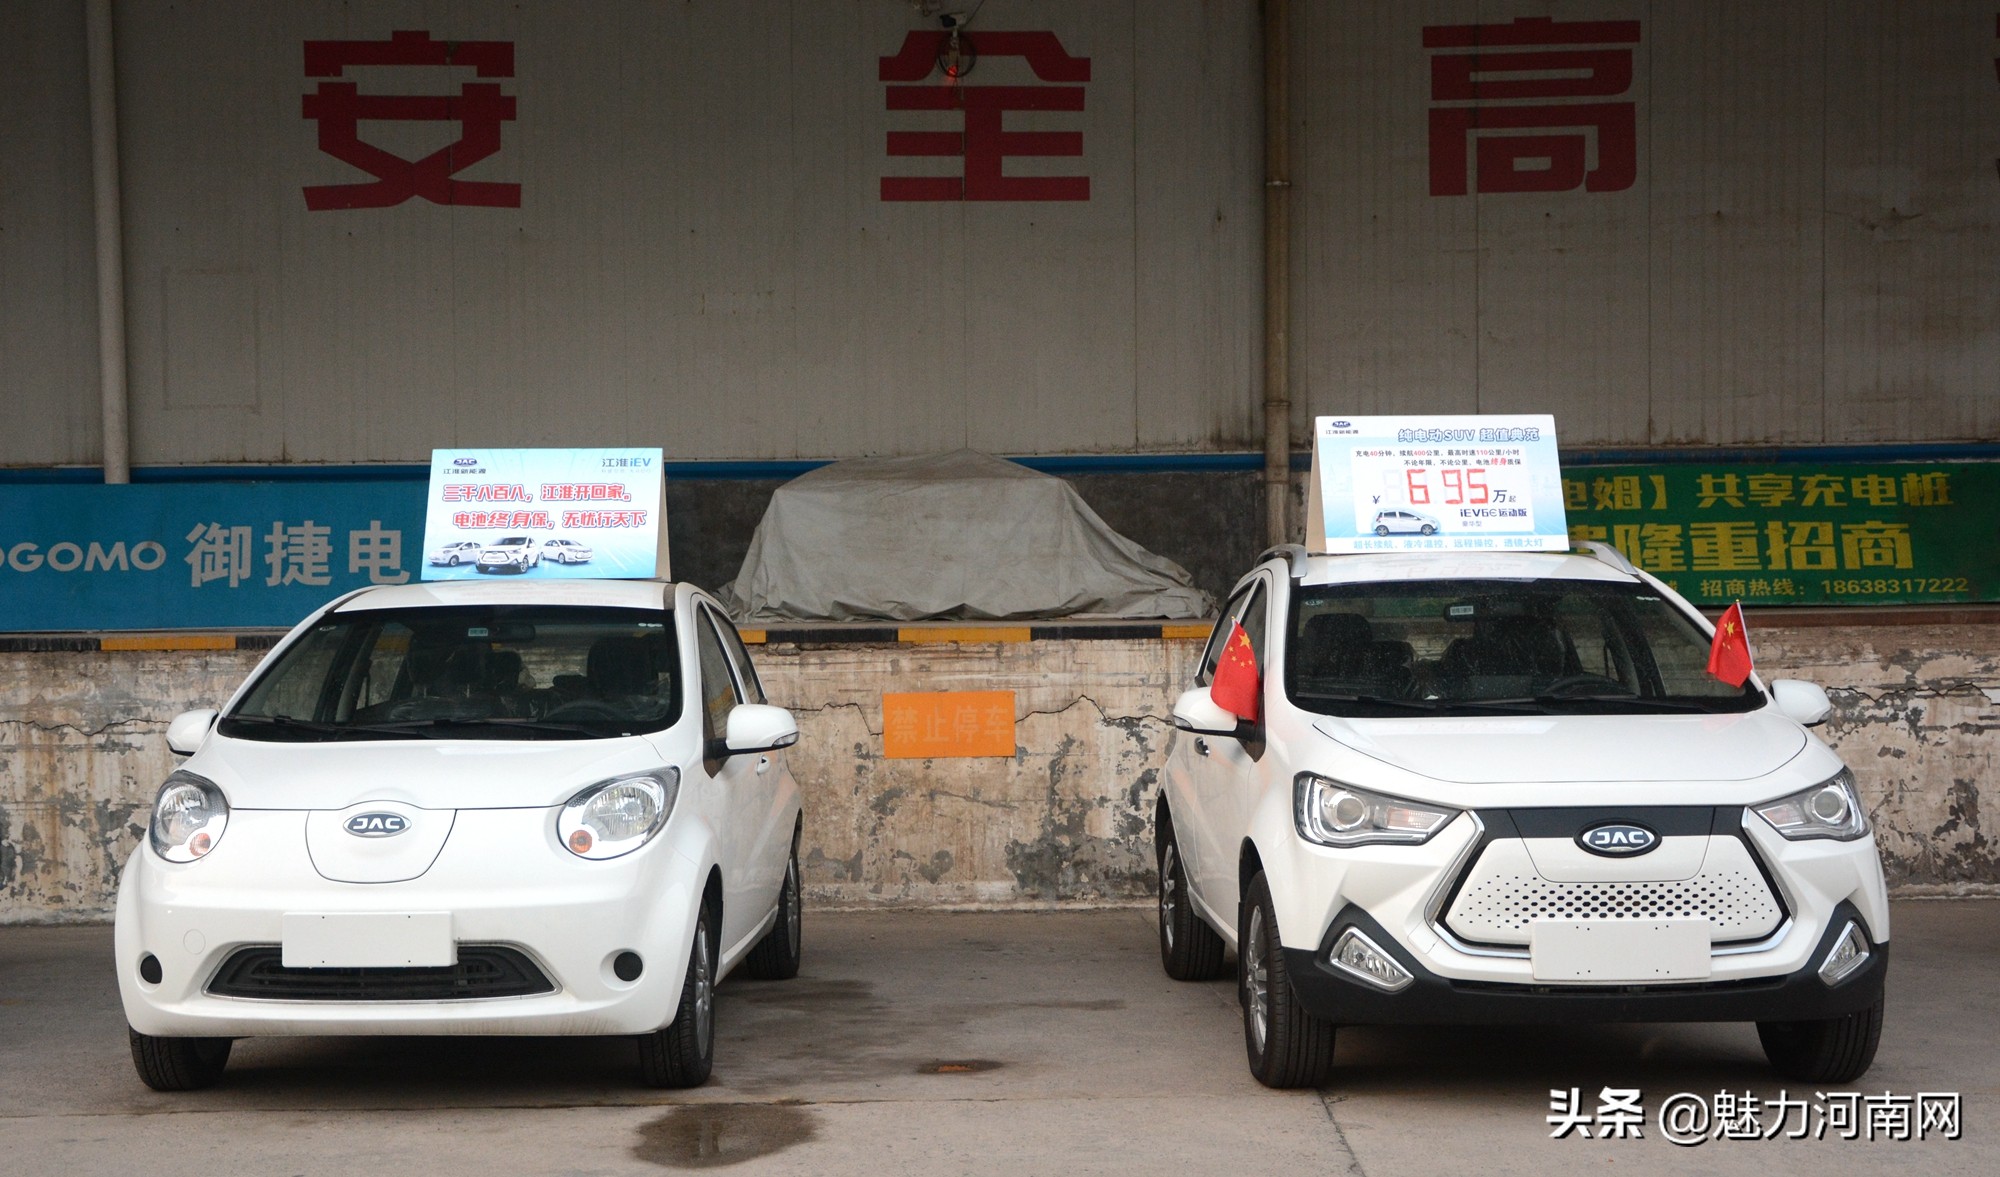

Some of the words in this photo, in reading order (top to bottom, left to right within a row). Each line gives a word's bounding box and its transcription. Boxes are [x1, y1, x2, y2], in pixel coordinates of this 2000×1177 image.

[302, 31, 521, 211] 安
[879, 31, 1091, 201] 全
[1422, 17, 1641, 196] 高
[1398, 428, 1475, 442] 纯电动SUV
[1480, 428, 1540, 441] 超值典范
[0, 540, 167, 573] GOMO
[185, 520, 410, 588] 御捷电
[892, 704, 1009, 743] 禁止停车
[353, 817, 401, 830] JAC
[1594, 831, 1645, 845] JAC
